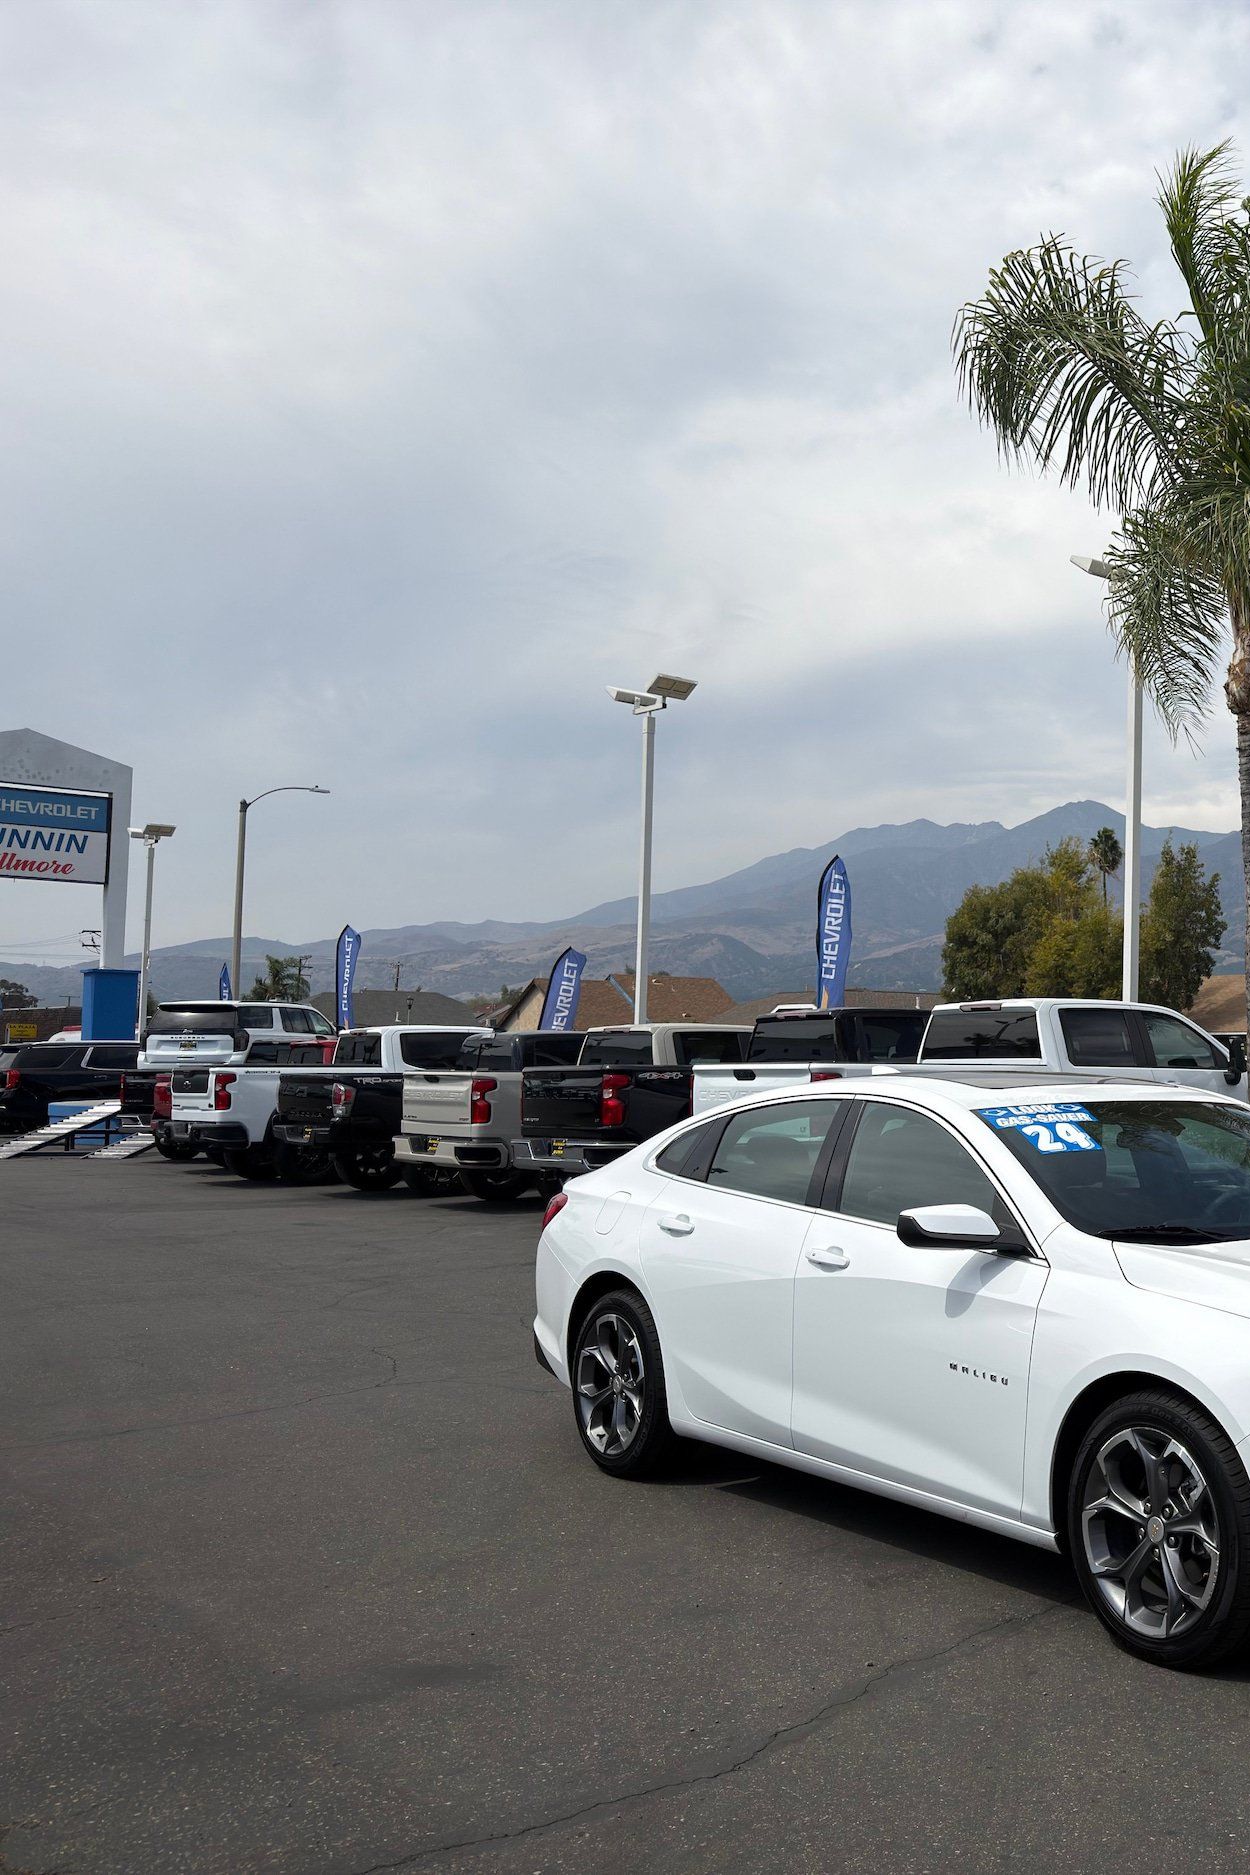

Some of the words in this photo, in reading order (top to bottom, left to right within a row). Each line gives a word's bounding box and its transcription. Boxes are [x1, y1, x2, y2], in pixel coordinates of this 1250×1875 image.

[0, 798, 100, 820] HEVROLET
[0, 852, 76, 875] llmore
[821, 869, 846, 980] CHEVROLET
[996, 1112, 1094, 1128] GAS-SAVER
[1007, 1104, 1062, 1115] LOOK
[1021, 1122, 1097, 1152] 24
[949, 1362, 1009, 1386] MALIBU
